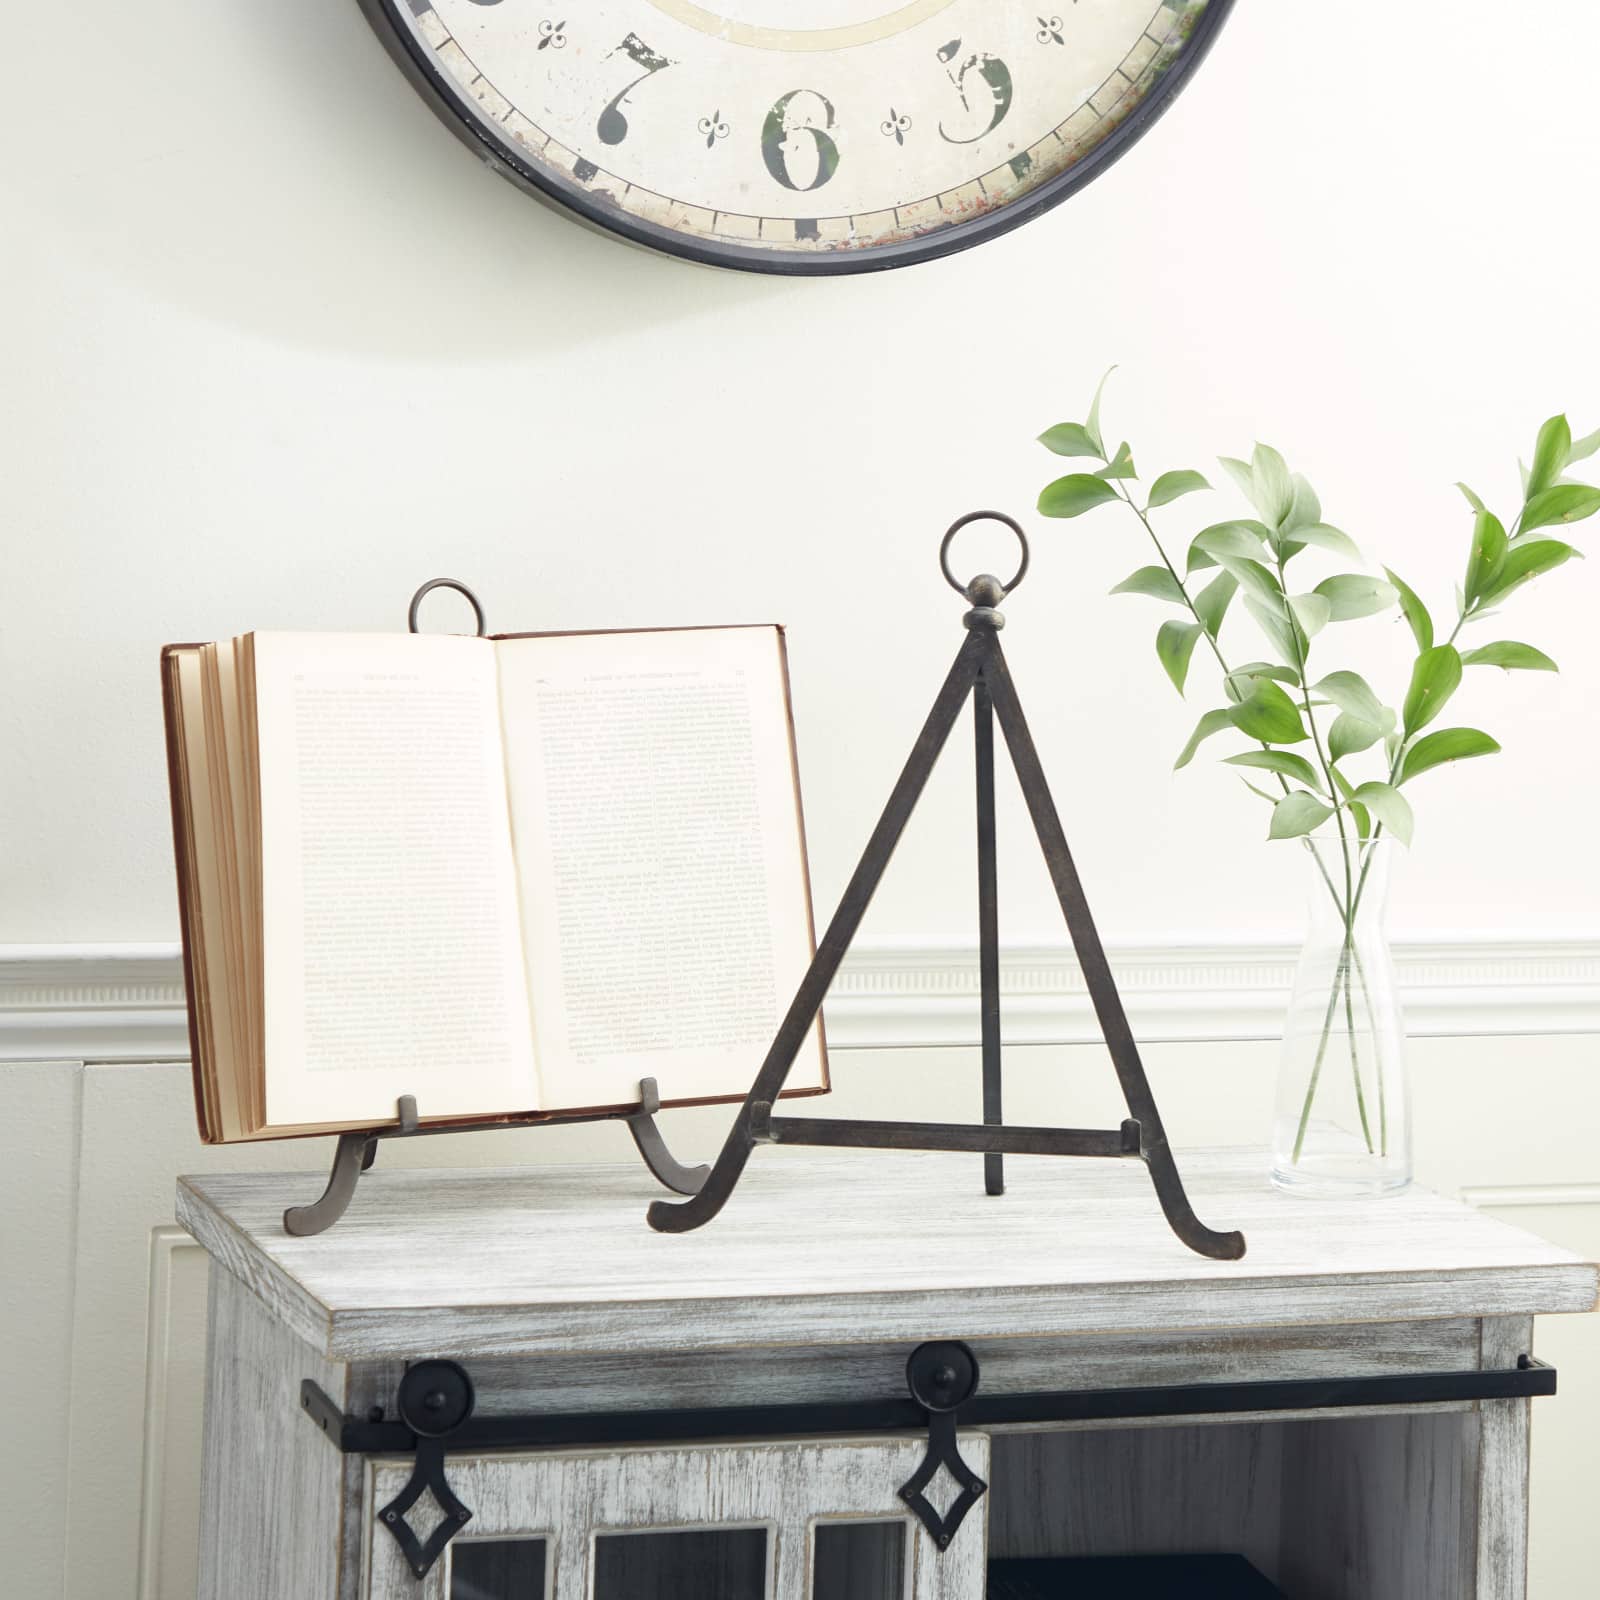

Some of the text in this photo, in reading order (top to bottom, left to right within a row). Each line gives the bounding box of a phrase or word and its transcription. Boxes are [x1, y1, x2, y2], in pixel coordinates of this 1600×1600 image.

[598, 31, 670, 145] 7
[761, 89, 840, 191] 6
[936, 38, 1013, 144] 5
